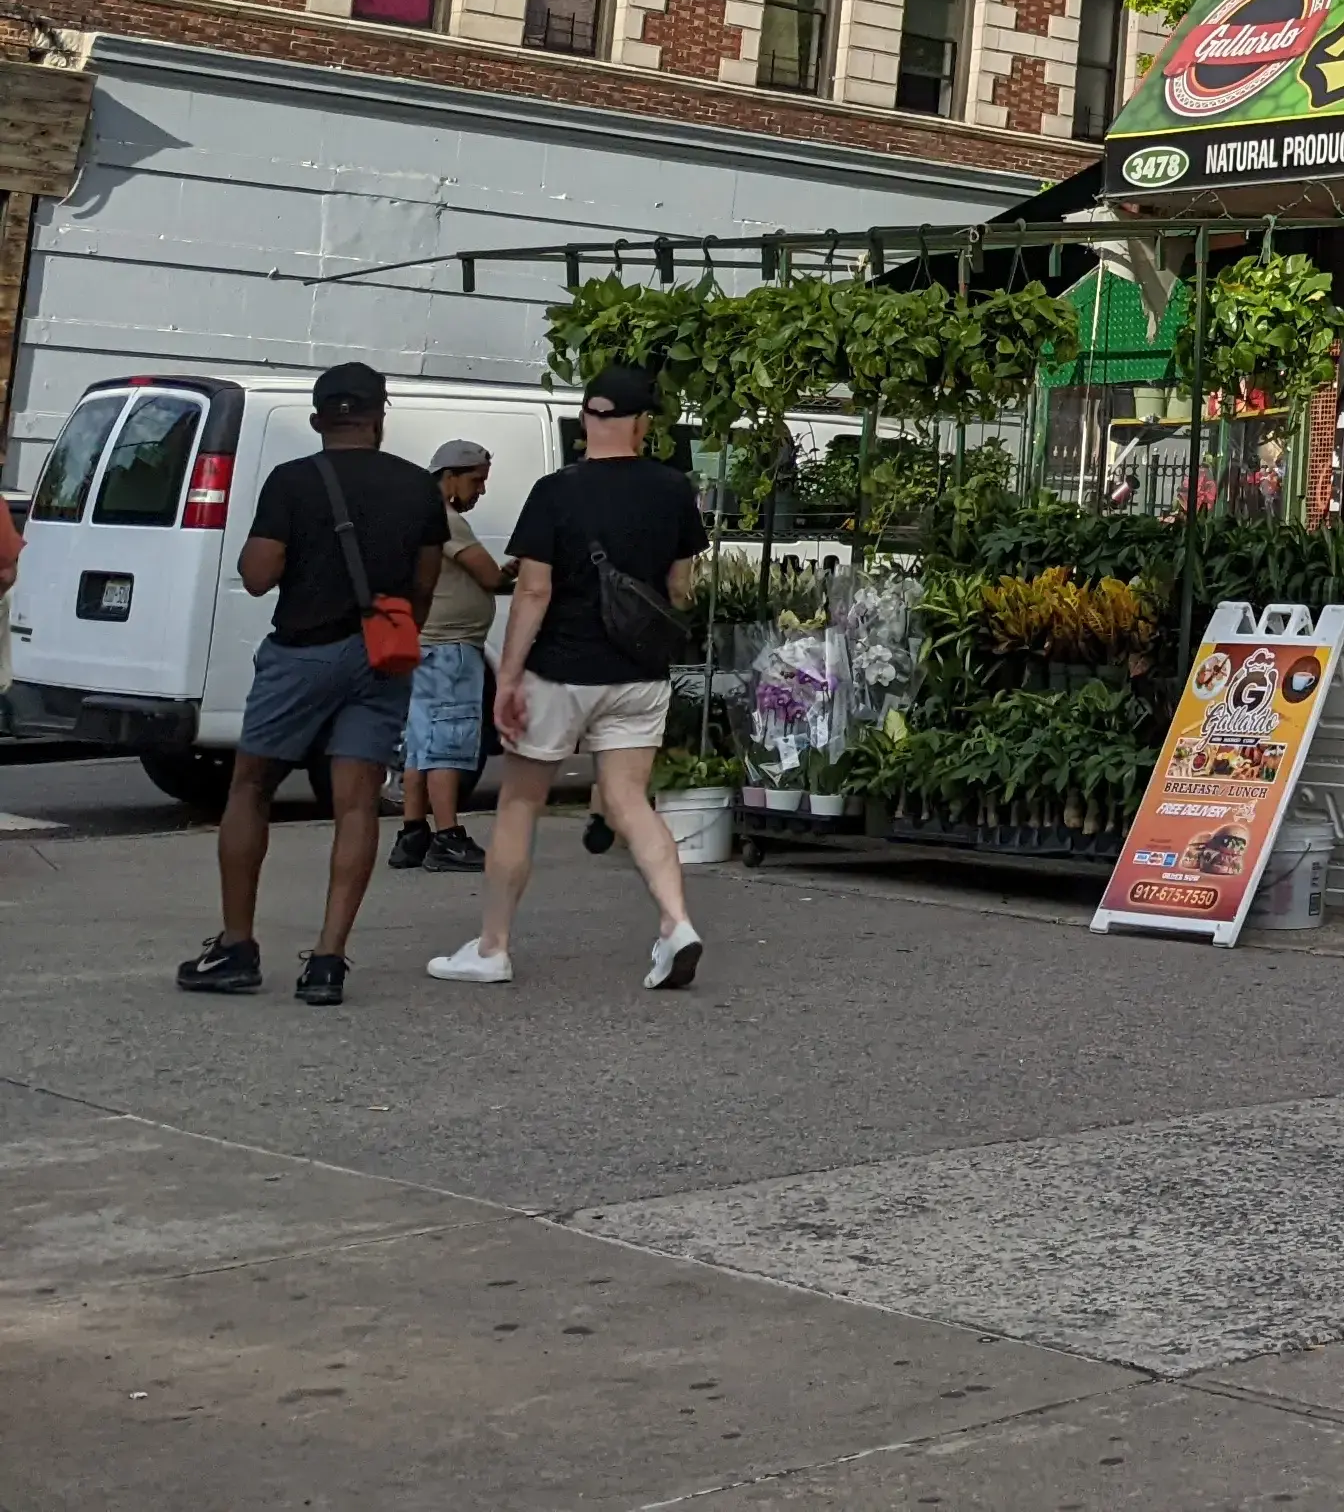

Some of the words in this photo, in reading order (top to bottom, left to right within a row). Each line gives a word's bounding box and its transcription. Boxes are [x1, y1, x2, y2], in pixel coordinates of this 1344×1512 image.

[1194, 18, 1305, 64] Gallardo
[1129, 154, 1180, 180] 3478
[1205, 138, 1278, 175] NATURAL
[1201, 702, 1279, 751] Gallardo
[1227, 785, 1268, 799] LUNCH
[1134, 884, 1215, 906] 917-675-7550
